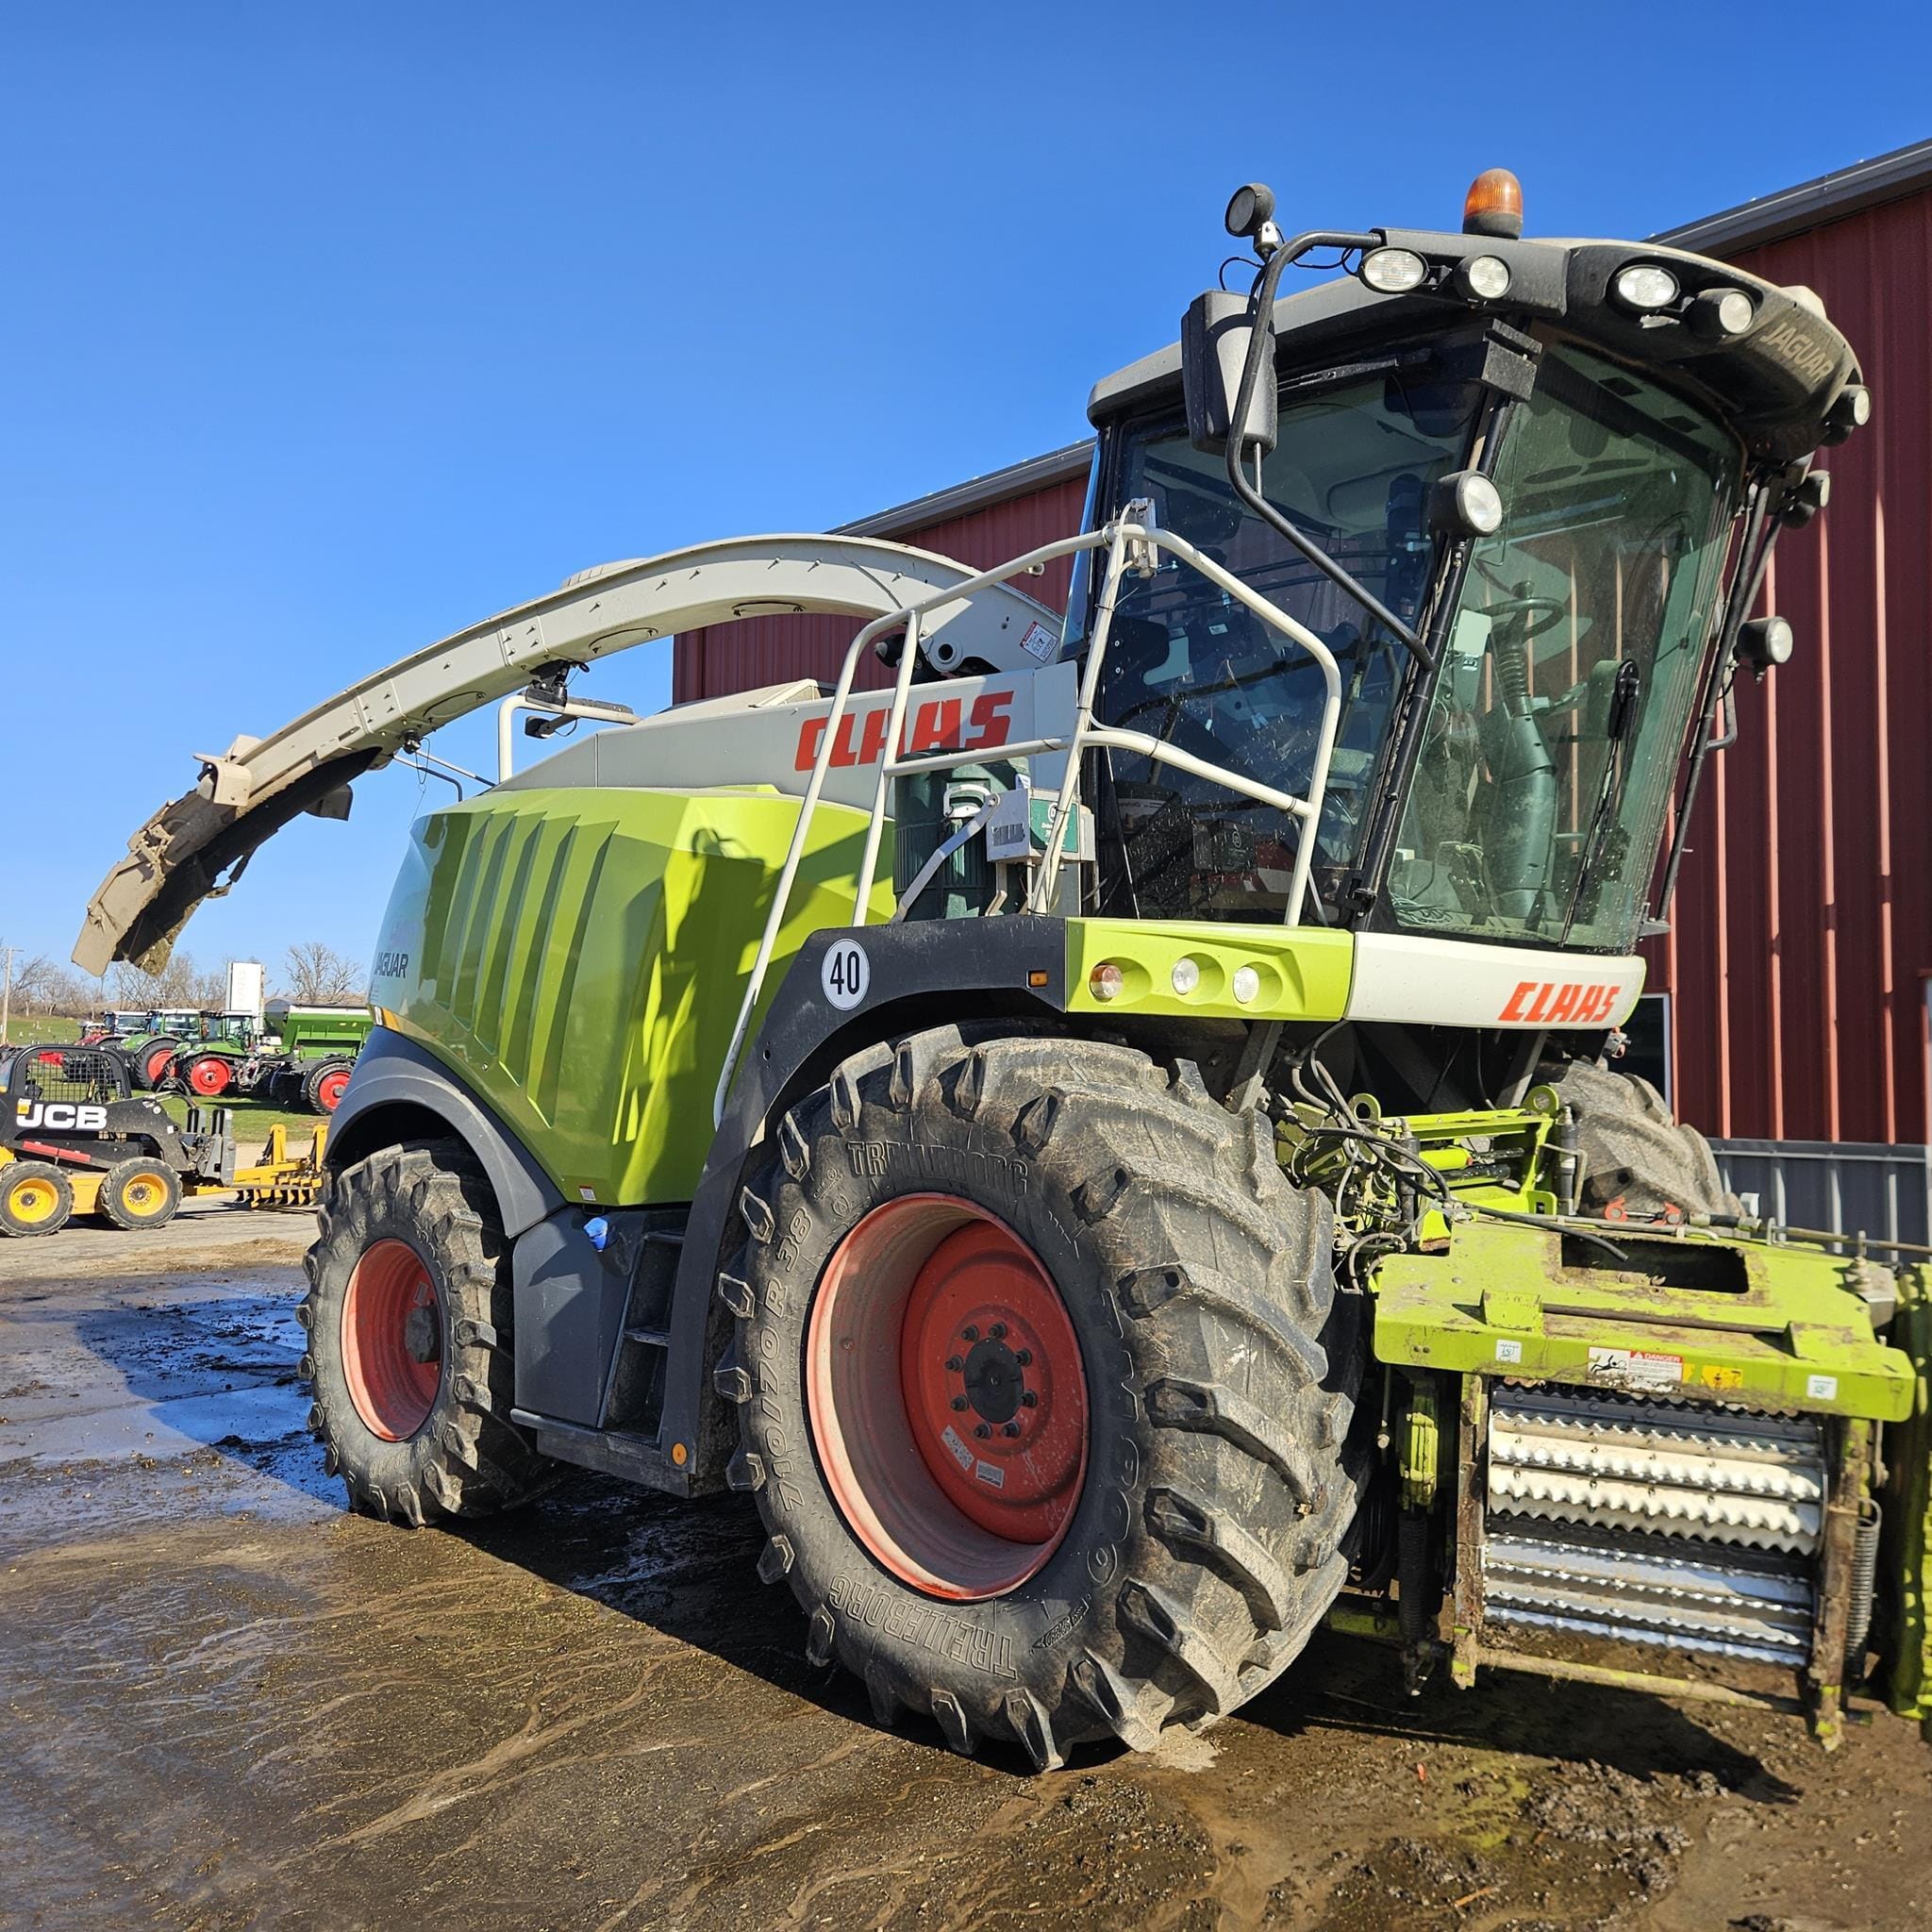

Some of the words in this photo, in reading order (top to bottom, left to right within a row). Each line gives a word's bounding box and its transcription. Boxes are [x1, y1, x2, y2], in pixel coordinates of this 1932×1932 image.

[1758, 322, 1834, 385] JAGUAR
[795, 691, 1014, 771] CLAAS
[830, 950, 859, 995] 40
[1498, 981, 1622, 1023] CLAAS
[16, 1103, 107, 1129] JCB
[1644, 1354, 1681, 1363] DANGER
[828, 1573, 1018, 1680] TRELLEBORG
